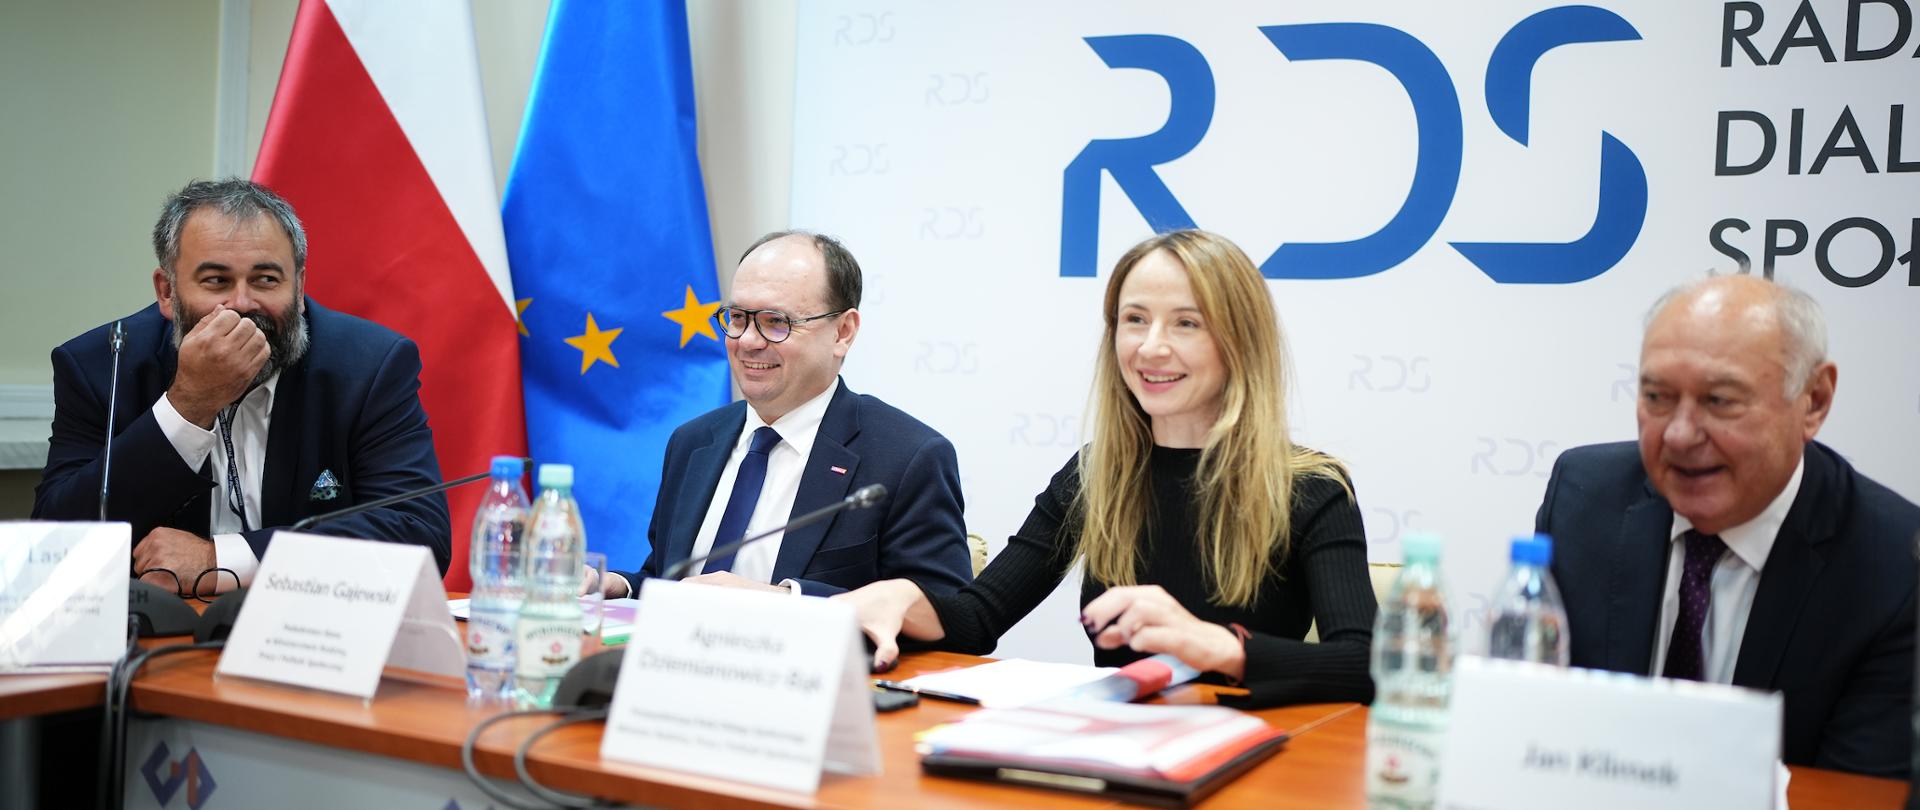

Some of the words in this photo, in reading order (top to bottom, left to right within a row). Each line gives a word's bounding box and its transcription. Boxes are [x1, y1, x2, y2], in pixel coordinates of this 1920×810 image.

[834, 10, 896, 47] RDS
[1721, 0, 1920, 67] RAD
[924, 71, 990, 109] RDS
[1059, 5, 1648, 284] RDS
[1715, 104, 1920, 176] DIAL
[829, 143, 891, 176] RDS
[920, 206, 984, 240] RDS
[914, 340, 980, 375] RDS
[1348, 354, 1432, 393] RDS
[265, 573, 331, 596] Sebastian
[334, 582, 400, 605] Gajewski
